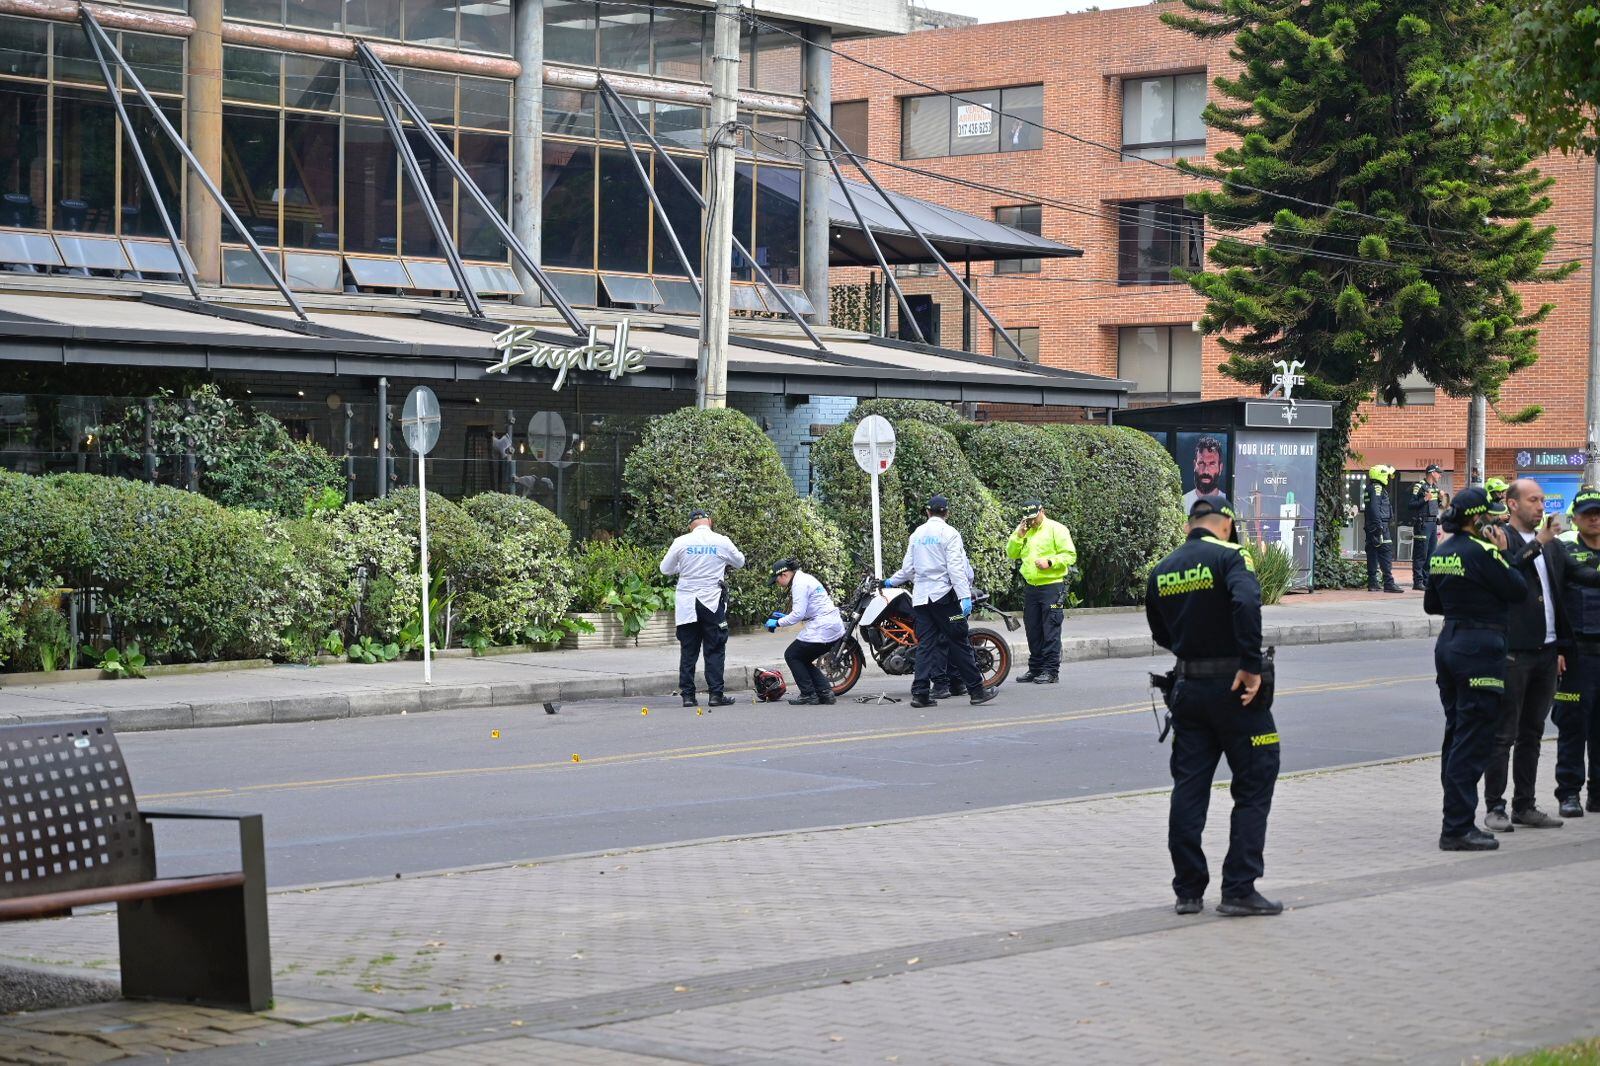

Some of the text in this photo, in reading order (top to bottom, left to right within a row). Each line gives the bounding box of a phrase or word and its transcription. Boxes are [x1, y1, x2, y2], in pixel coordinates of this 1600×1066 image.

[485, 317, 647, 392] Bagatelle
[1238, 443, 1315, 457] YOUR LIFE, YOUR WAY
[1535, 452, 1568, 466] LÍNEA
[1263, 477, 1288, 485] IGNITE
[686, 547, 717, 555] SIJIN
[1429, 552, 1462, 567] POLICÍA
[1156, 563, 1214, 588] POLICÍA
